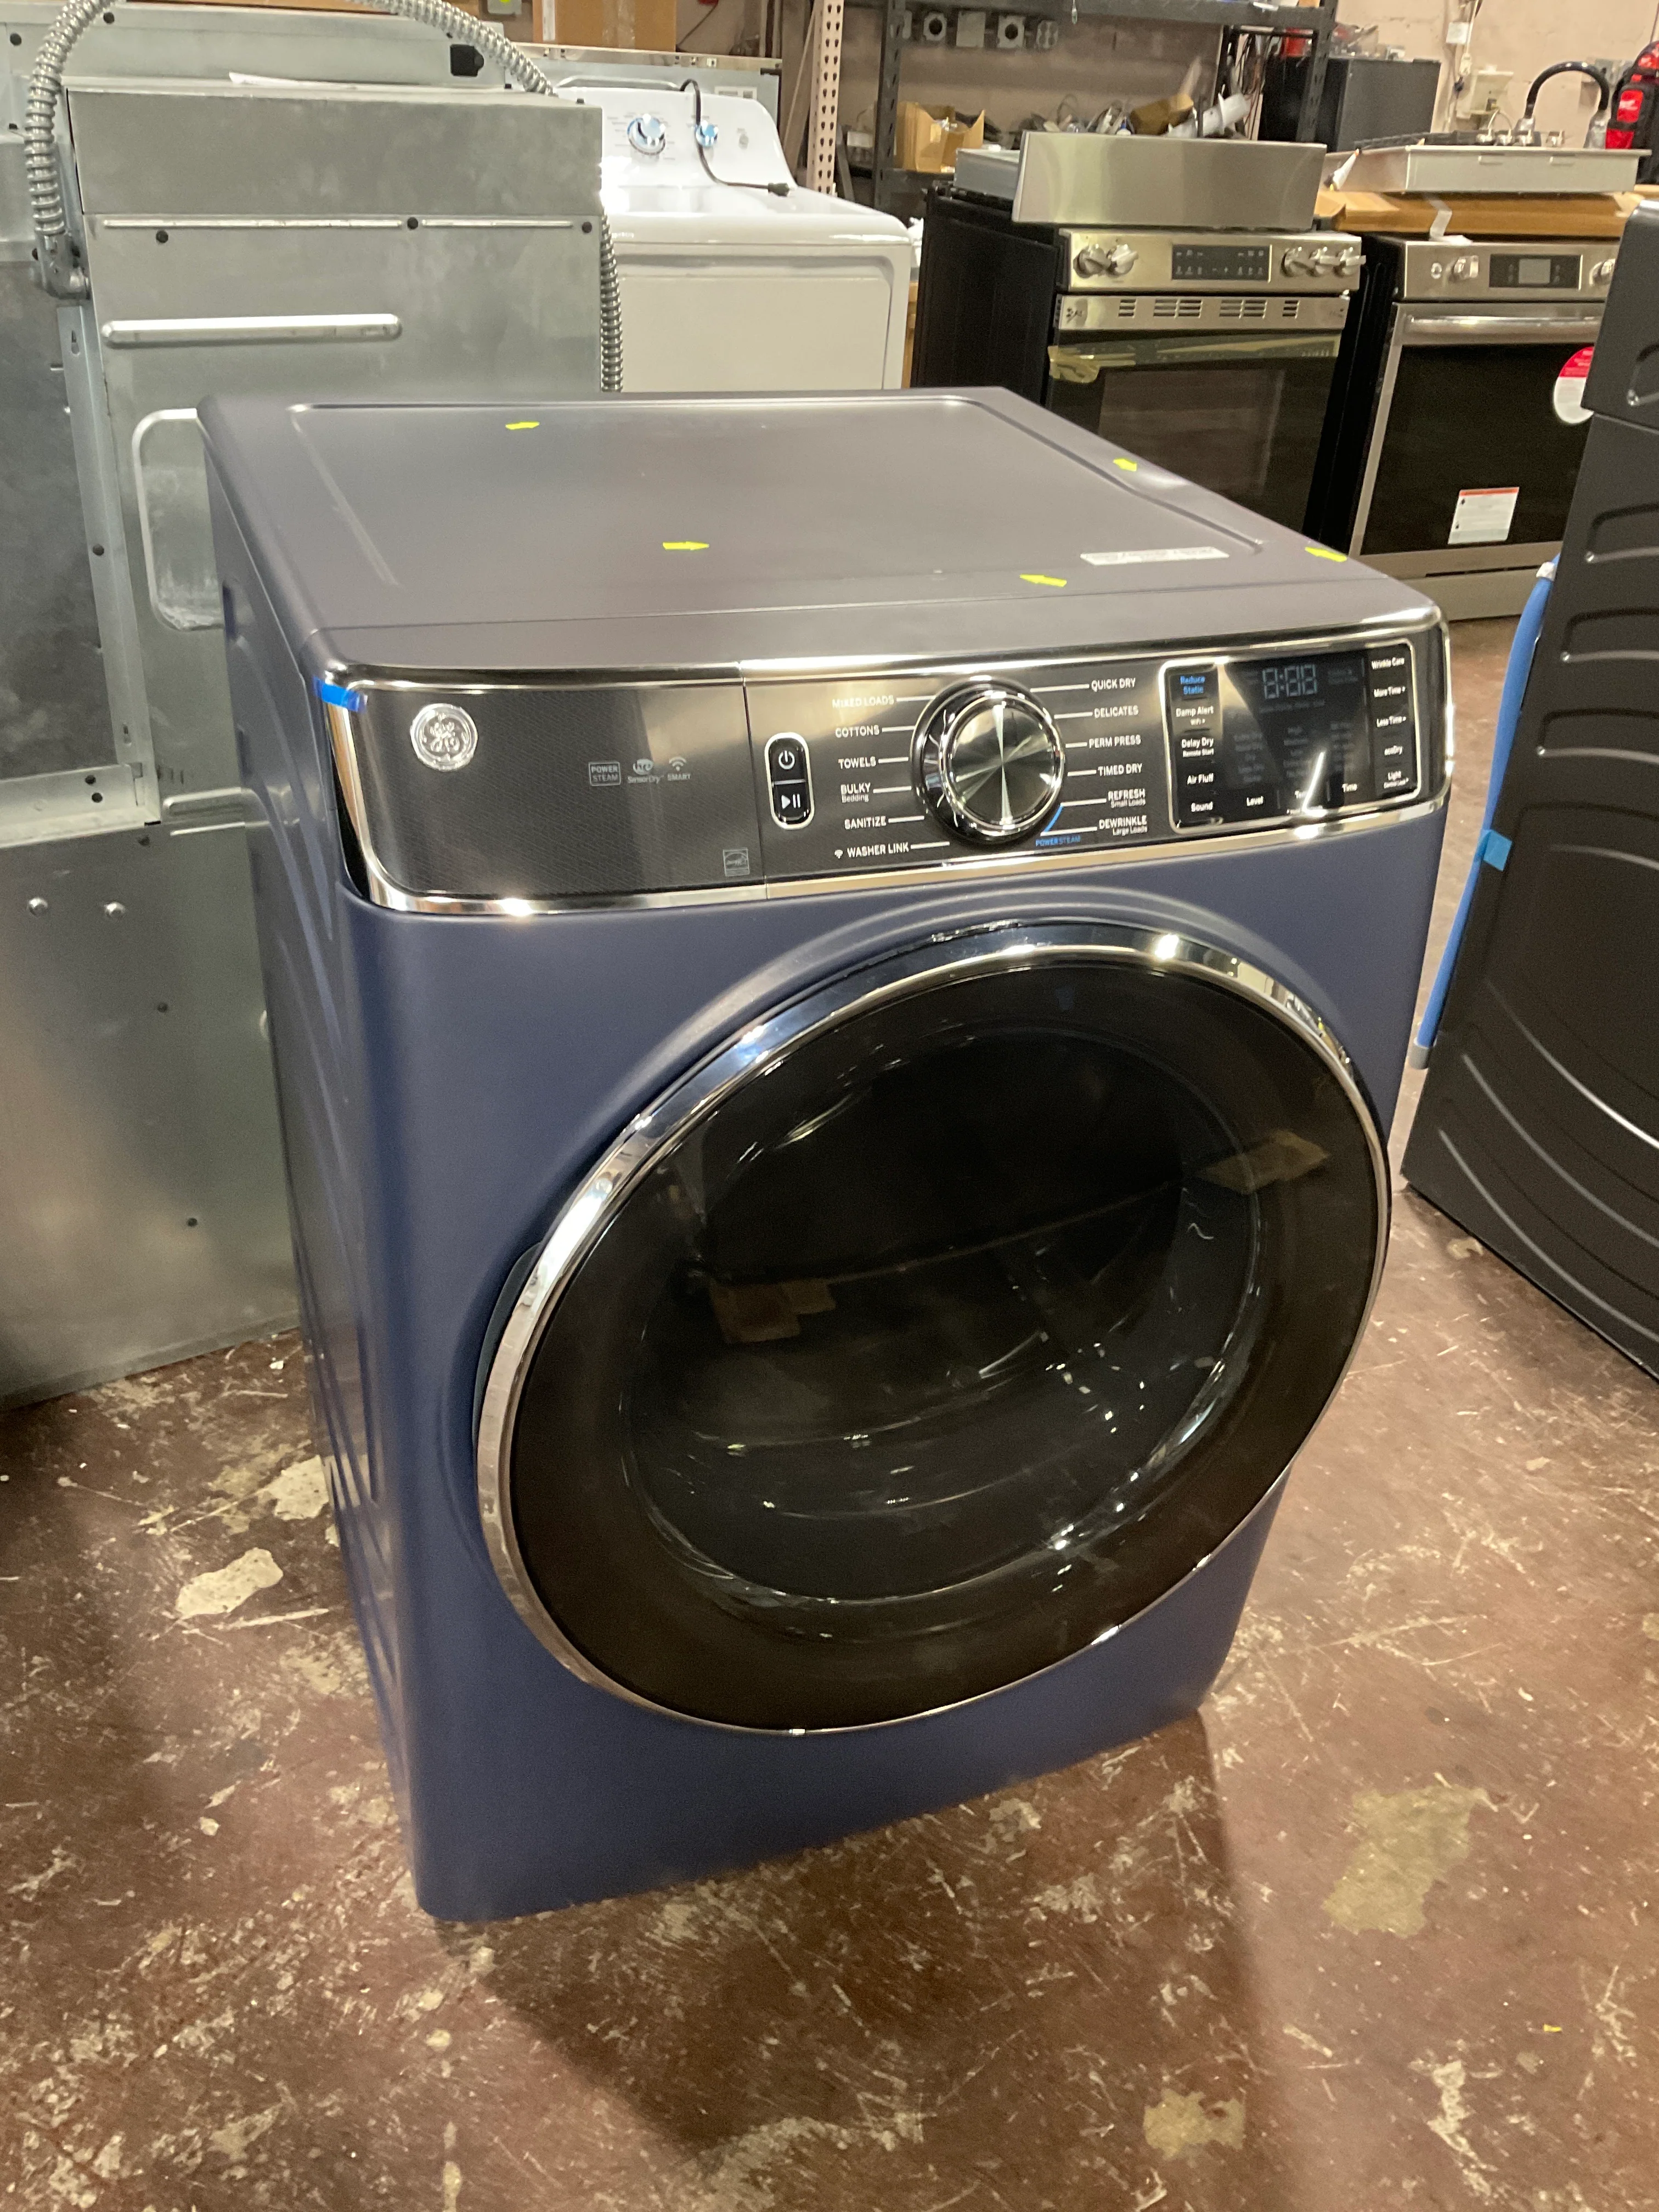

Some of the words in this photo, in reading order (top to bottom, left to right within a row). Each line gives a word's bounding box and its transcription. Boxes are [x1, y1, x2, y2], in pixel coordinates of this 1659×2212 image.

[1091, 679, 1118, 692] QUICK
[1119, 678, 1136, 689] DRY
[832, 697, 862, 708] MIXED
[864, 695, 894, 706] LOADS
[1094, 705, 1139, 718] DELICATES
[1176, 708, 1196, 717] Damp
[1197, 706, 1214, 715] Alert
[835, 725, 879, 738] COTTONS
[1089, 737, 1113, 748] PERM
[1114, 735, 1141, 746] PRESS
[1181, 738, 1200, 748] Delay
[1201, 737, 1214, 747] Dry
[838, 756, 876, 769] TOWELS
[591, 765, 618, 774] POWER
[1098, 765, 1124, 776] TIMED
[1126, 763, 1142, 774] DRY
[592, 774, 618, 782] STEAM
[667, 773, 691, 781] SMART
[1187, 775, 1197, 785] Air
[1198, 772, 1214, 783] Fluff
[840, 782, 871, 794] BULKY
[1108, 788, 1146, 800] REFRESH
[842, 794, 869, 803] Bedding
[1110, 799, 1127, 808] Small
[1128, 798, 1146, 806] Loads
[1246, 796, 1263, 806] Level
[1191, 801, 1213, 812] Sound
[844, 816, 887, 830] SANITIZE
[1099, 815, 1147, 830] DEWRINKLE
[1113, 828, 1130, 837] Large
[1130, 826, 1147, 834] Loads
[847, 844, 886, 857] WASHER
[888, 842, 909, 854] LINK
